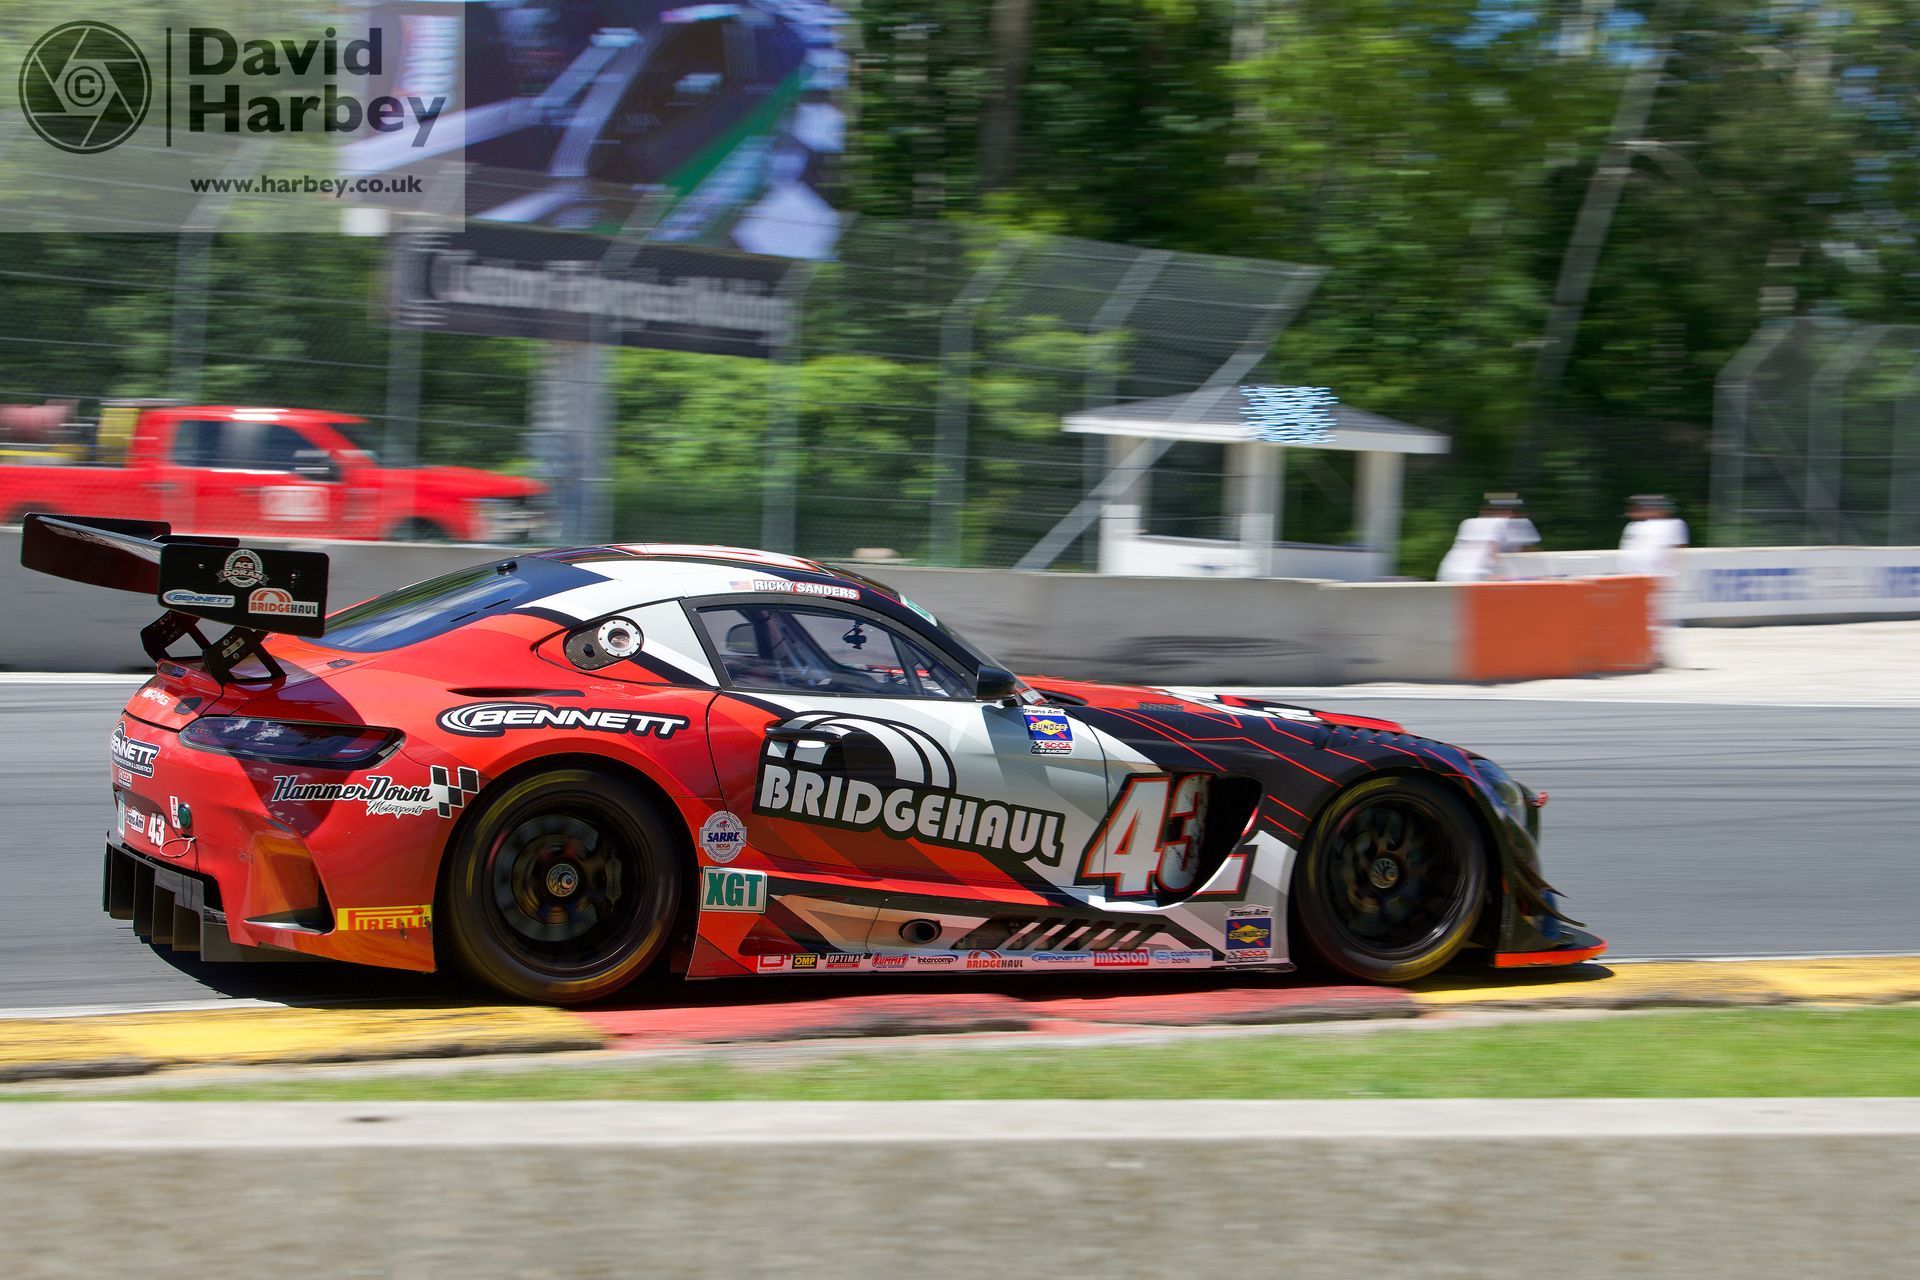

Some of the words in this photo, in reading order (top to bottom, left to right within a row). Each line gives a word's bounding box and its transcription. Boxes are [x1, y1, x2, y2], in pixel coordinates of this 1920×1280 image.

[234, 561, 254, 569] ACE
[223, 569, 264, 581] DORAN
[755, 580, 794, 591] RICKY
[795, 583, 859, 599] SANDERS
[173, 594, 233, 603] BENNETT
[251, 601, 317, 615] BRIDGEHAUL
[469, 709, 686, 735] BENNETT
[1032, 723, 1066, 731] SUNOCO
[273, 777, 433, 801] HammerDown
[367, 801, 424, 817] Motorsports
[759, 763, 1062, 859] BRIDGEHAUL
[148, 813, 165, 846] 43
[706, 872, 762, 907] XGT
[348, 908, 424, 930] PIRELLI
[795, 957, 815, 965] OMP
[829, 955, 859, 963] OPTIMA
[873, 953, 909, 967] SUMMIT
[918, 957, 954, 965] Intercomp
[967, 959, 1024, 968] BRIDGEHAUL
[1096, 951, 1148, 964] mission
